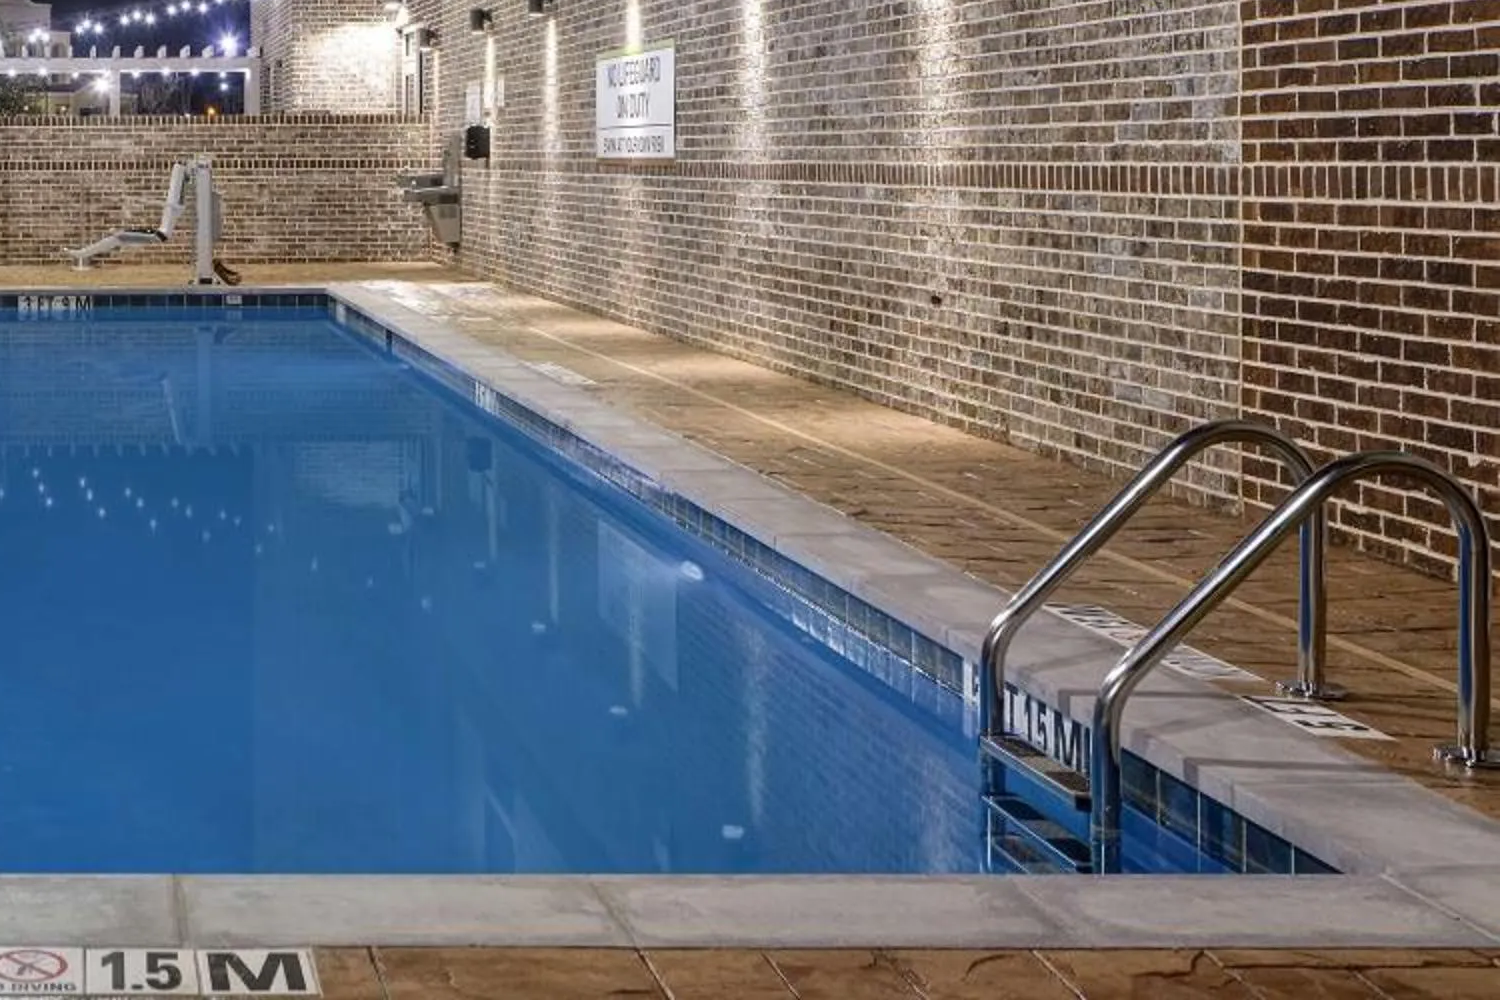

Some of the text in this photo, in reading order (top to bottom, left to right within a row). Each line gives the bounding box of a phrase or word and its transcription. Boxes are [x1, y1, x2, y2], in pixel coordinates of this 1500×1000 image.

[101, 951, 307, 991] 1.5 M
[11, 983, 77, 991] DIVING
